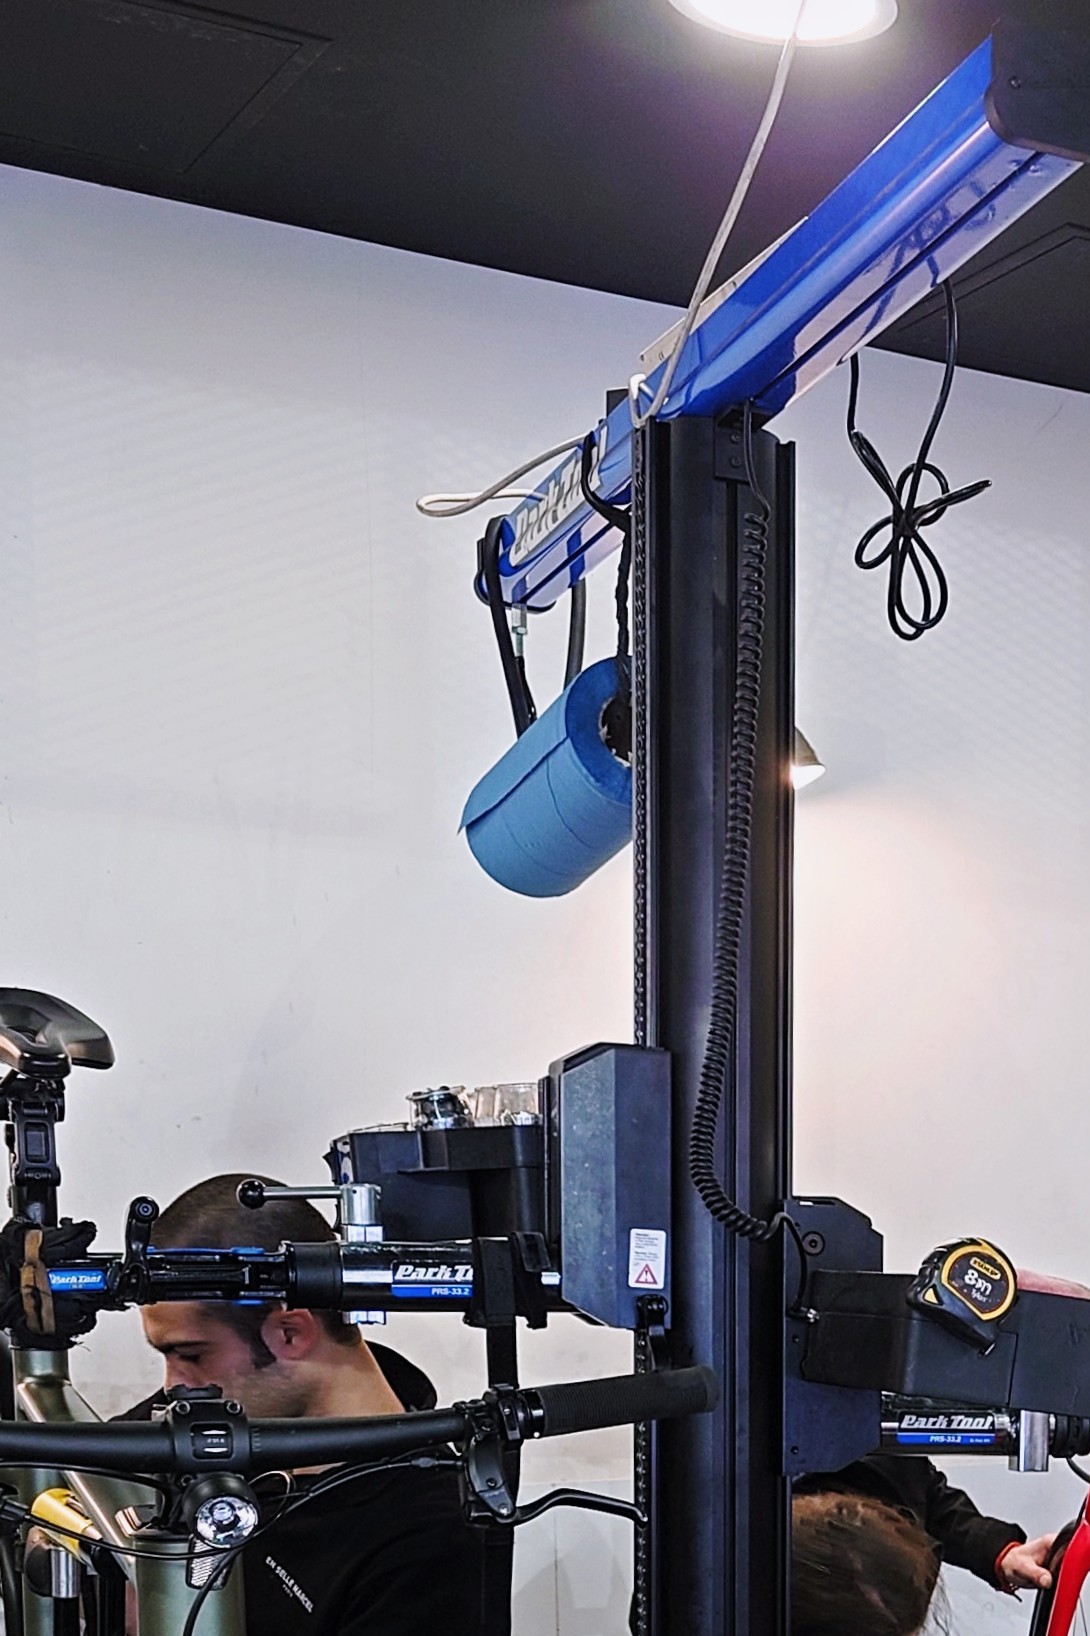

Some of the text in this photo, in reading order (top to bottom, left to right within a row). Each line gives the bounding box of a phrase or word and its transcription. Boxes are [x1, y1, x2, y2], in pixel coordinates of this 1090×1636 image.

[431, 1287, 469, 1296] PRS-33.2
[964, 1269, 992, 1296] 8m
[275, 1566, 295, 1588] SELLE
[292, 1584, 314, 1613] MARCEL
